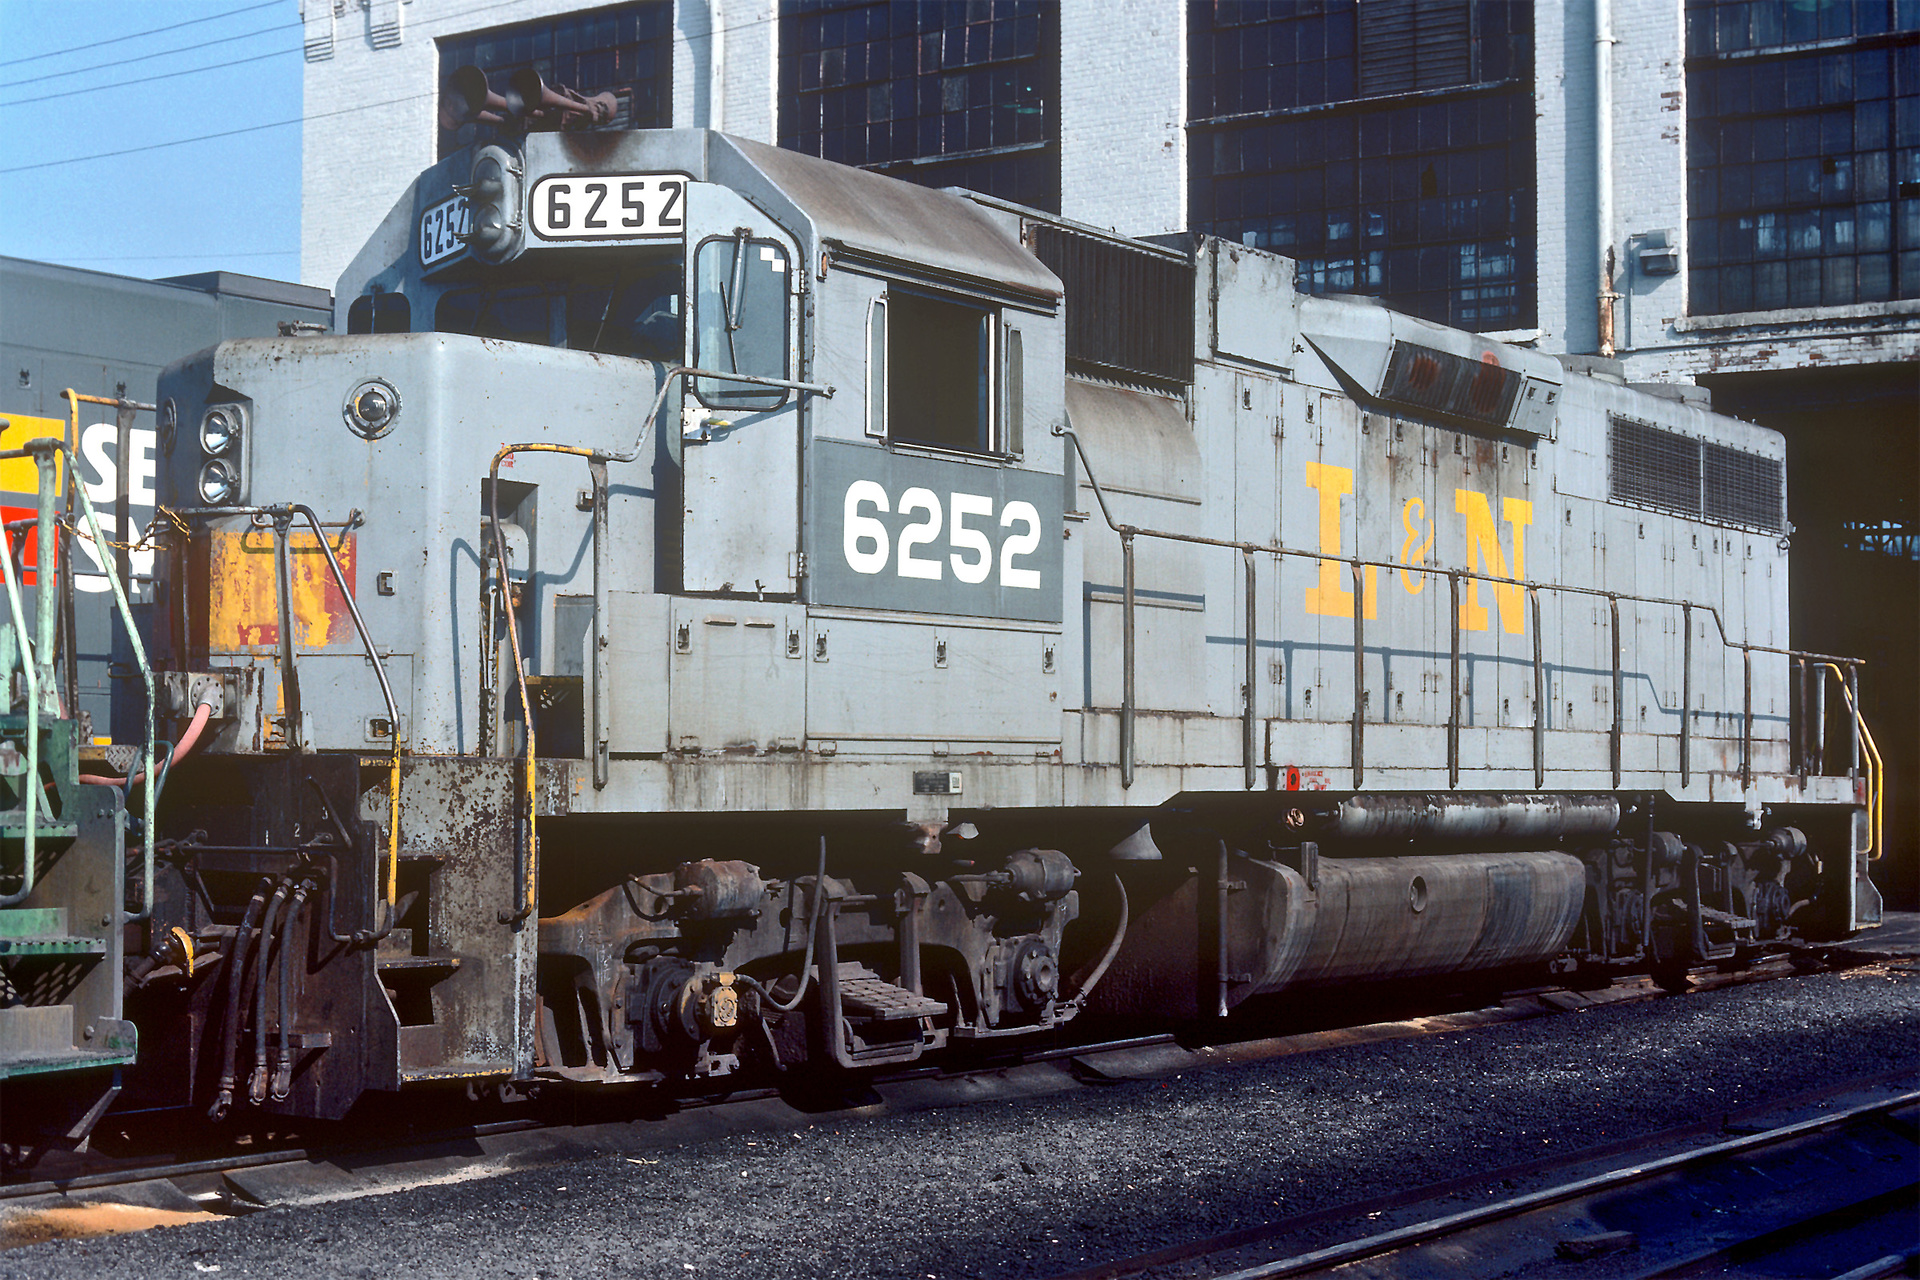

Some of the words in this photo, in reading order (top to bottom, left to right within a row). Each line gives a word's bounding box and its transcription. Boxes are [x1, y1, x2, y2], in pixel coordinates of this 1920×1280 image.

[424, 197, 468, 259] 6252
[548, 181, 682, 229] 6252
[843, 479, 1041, 589] 6252
[1305, 461, 1377, 620] L
[1400, 497, 1435, 595] &
[1455, 488, 1533, 635] N
